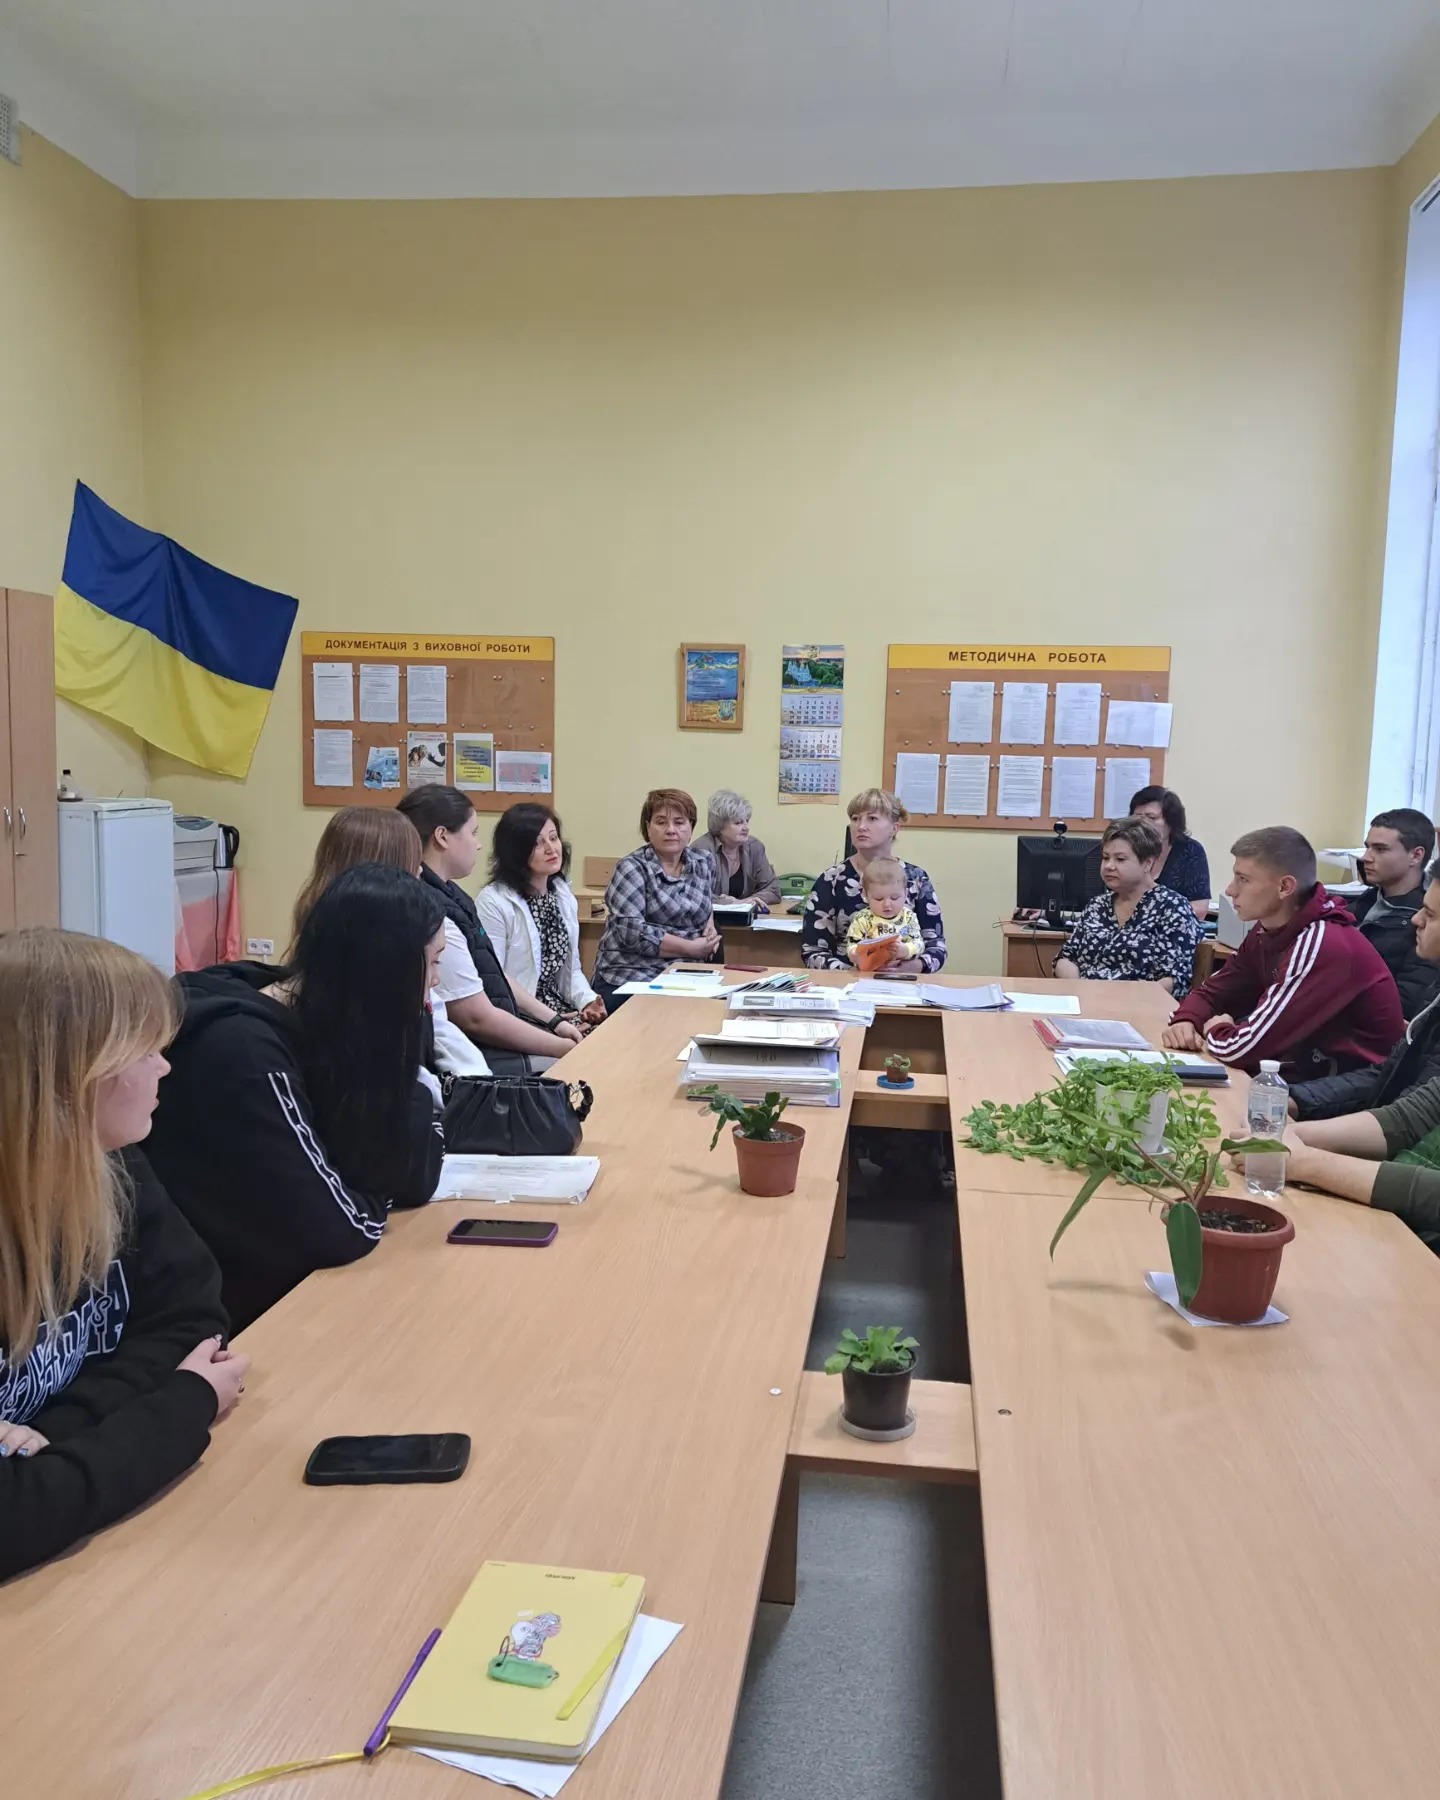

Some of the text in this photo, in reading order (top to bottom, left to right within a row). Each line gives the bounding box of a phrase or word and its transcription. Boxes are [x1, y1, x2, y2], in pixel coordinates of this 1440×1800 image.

[325, 639, 531, 653] ДОКУМЕНТАЦІЯ З ВИХОВНОЇ РОБОТИ
[948, 651, 1107, 663] МЕТОДИЧНА РОБОТА
